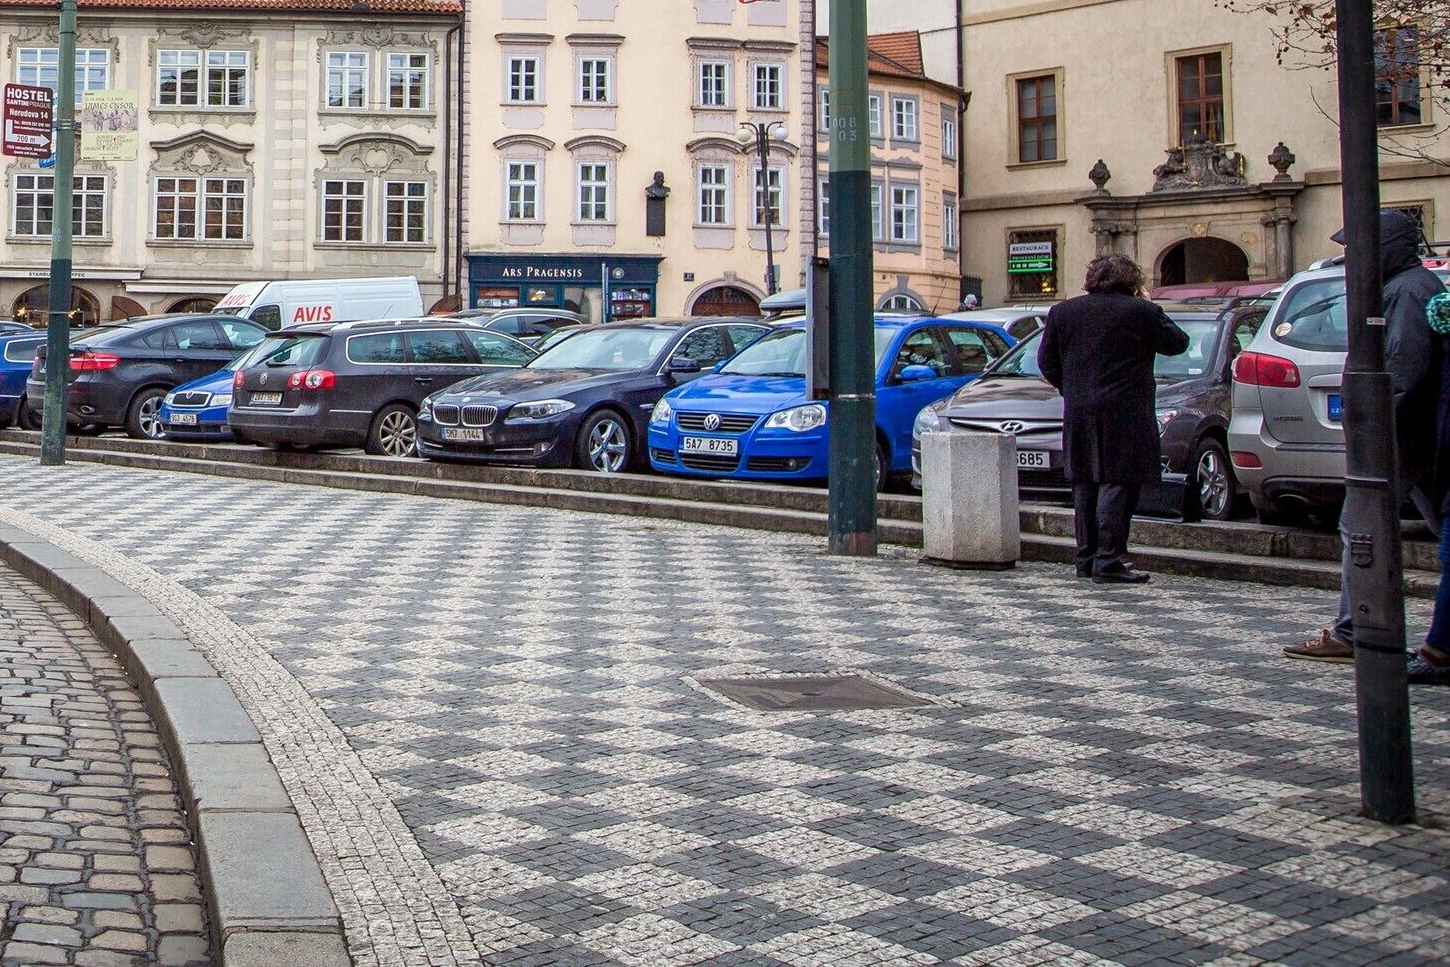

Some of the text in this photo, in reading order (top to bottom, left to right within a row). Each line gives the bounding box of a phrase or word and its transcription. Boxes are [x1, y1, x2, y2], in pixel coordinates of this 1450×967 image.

[6, 87, 51, 102] HOSTEL
[10, 108, 39, 118] Nerudova
[502, 266, 582, 278] ARS PRAGENSIS
[221, 294, 250, 306] AVIS
[294, 306, 332, 322] AVIS
[686, 438, 733, 451] 5A7 8735
[1016, 453, 1043, 465] 685
